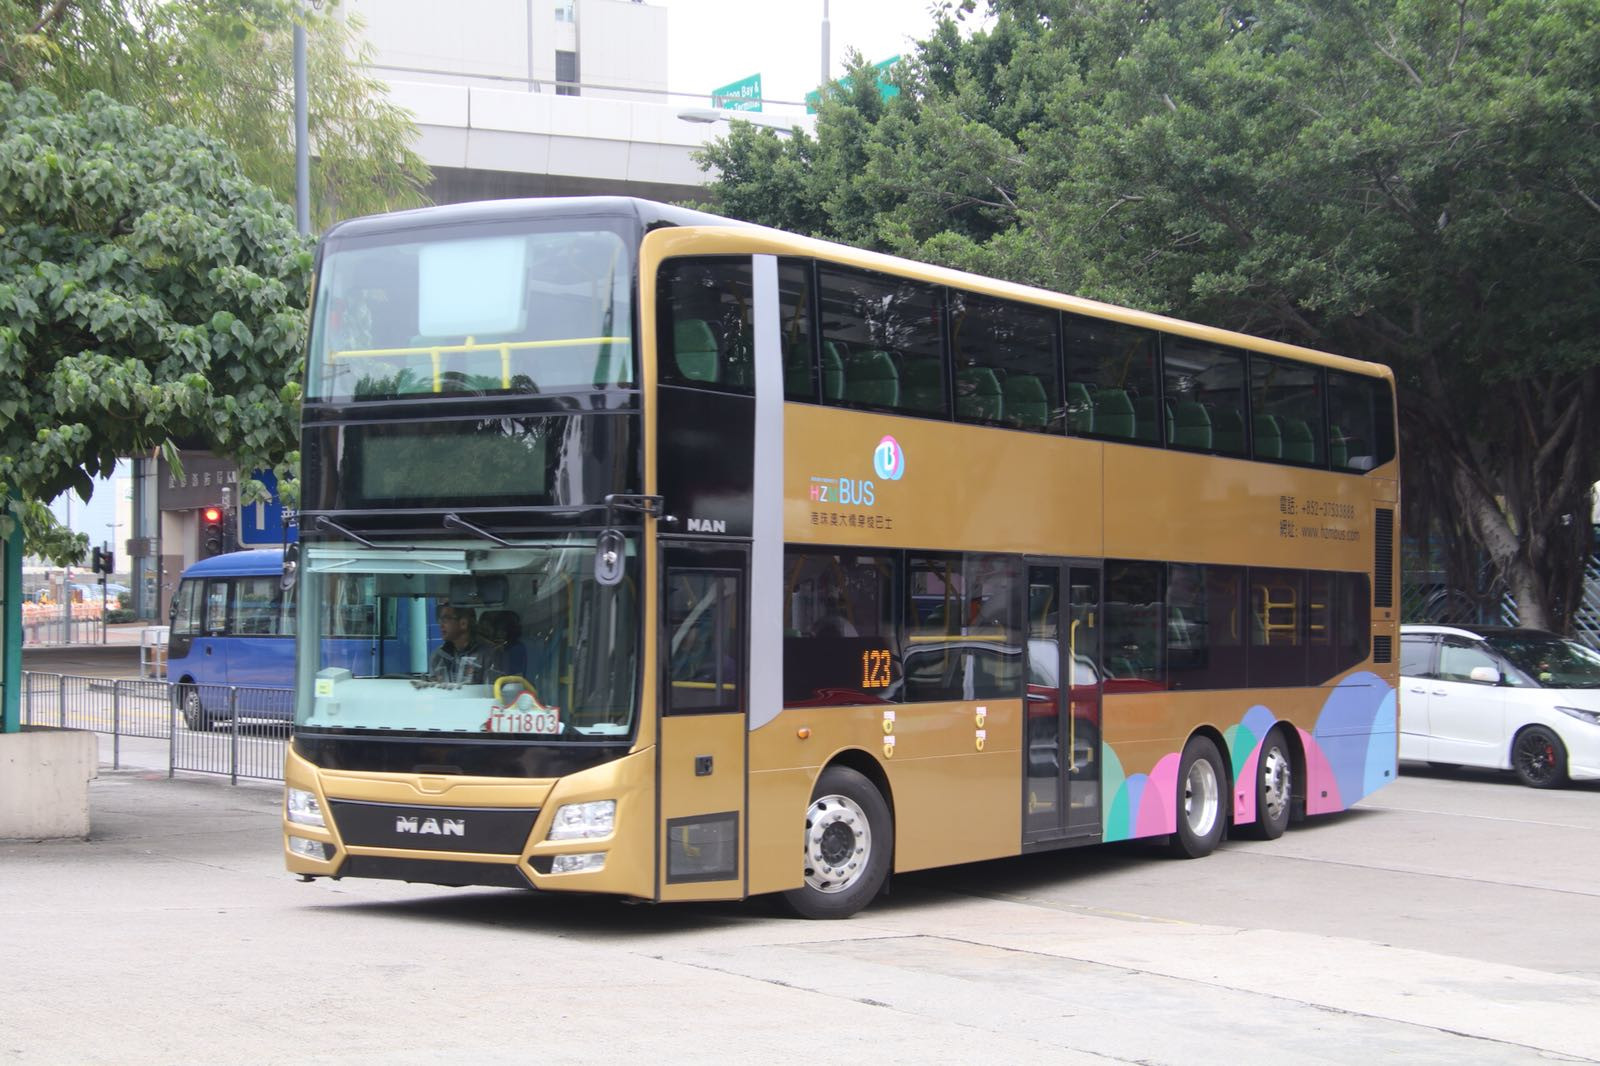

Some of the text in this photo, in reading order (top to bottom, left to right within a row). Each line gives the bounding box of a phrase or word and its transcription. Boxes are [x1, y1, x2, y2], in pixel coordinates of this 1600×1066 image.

[741, 85, 754, 98] Bay
[687, 518, 726, 533] MAN
[862, 650, 891, 688] 123
[396, 816, 465, 836] MAN
